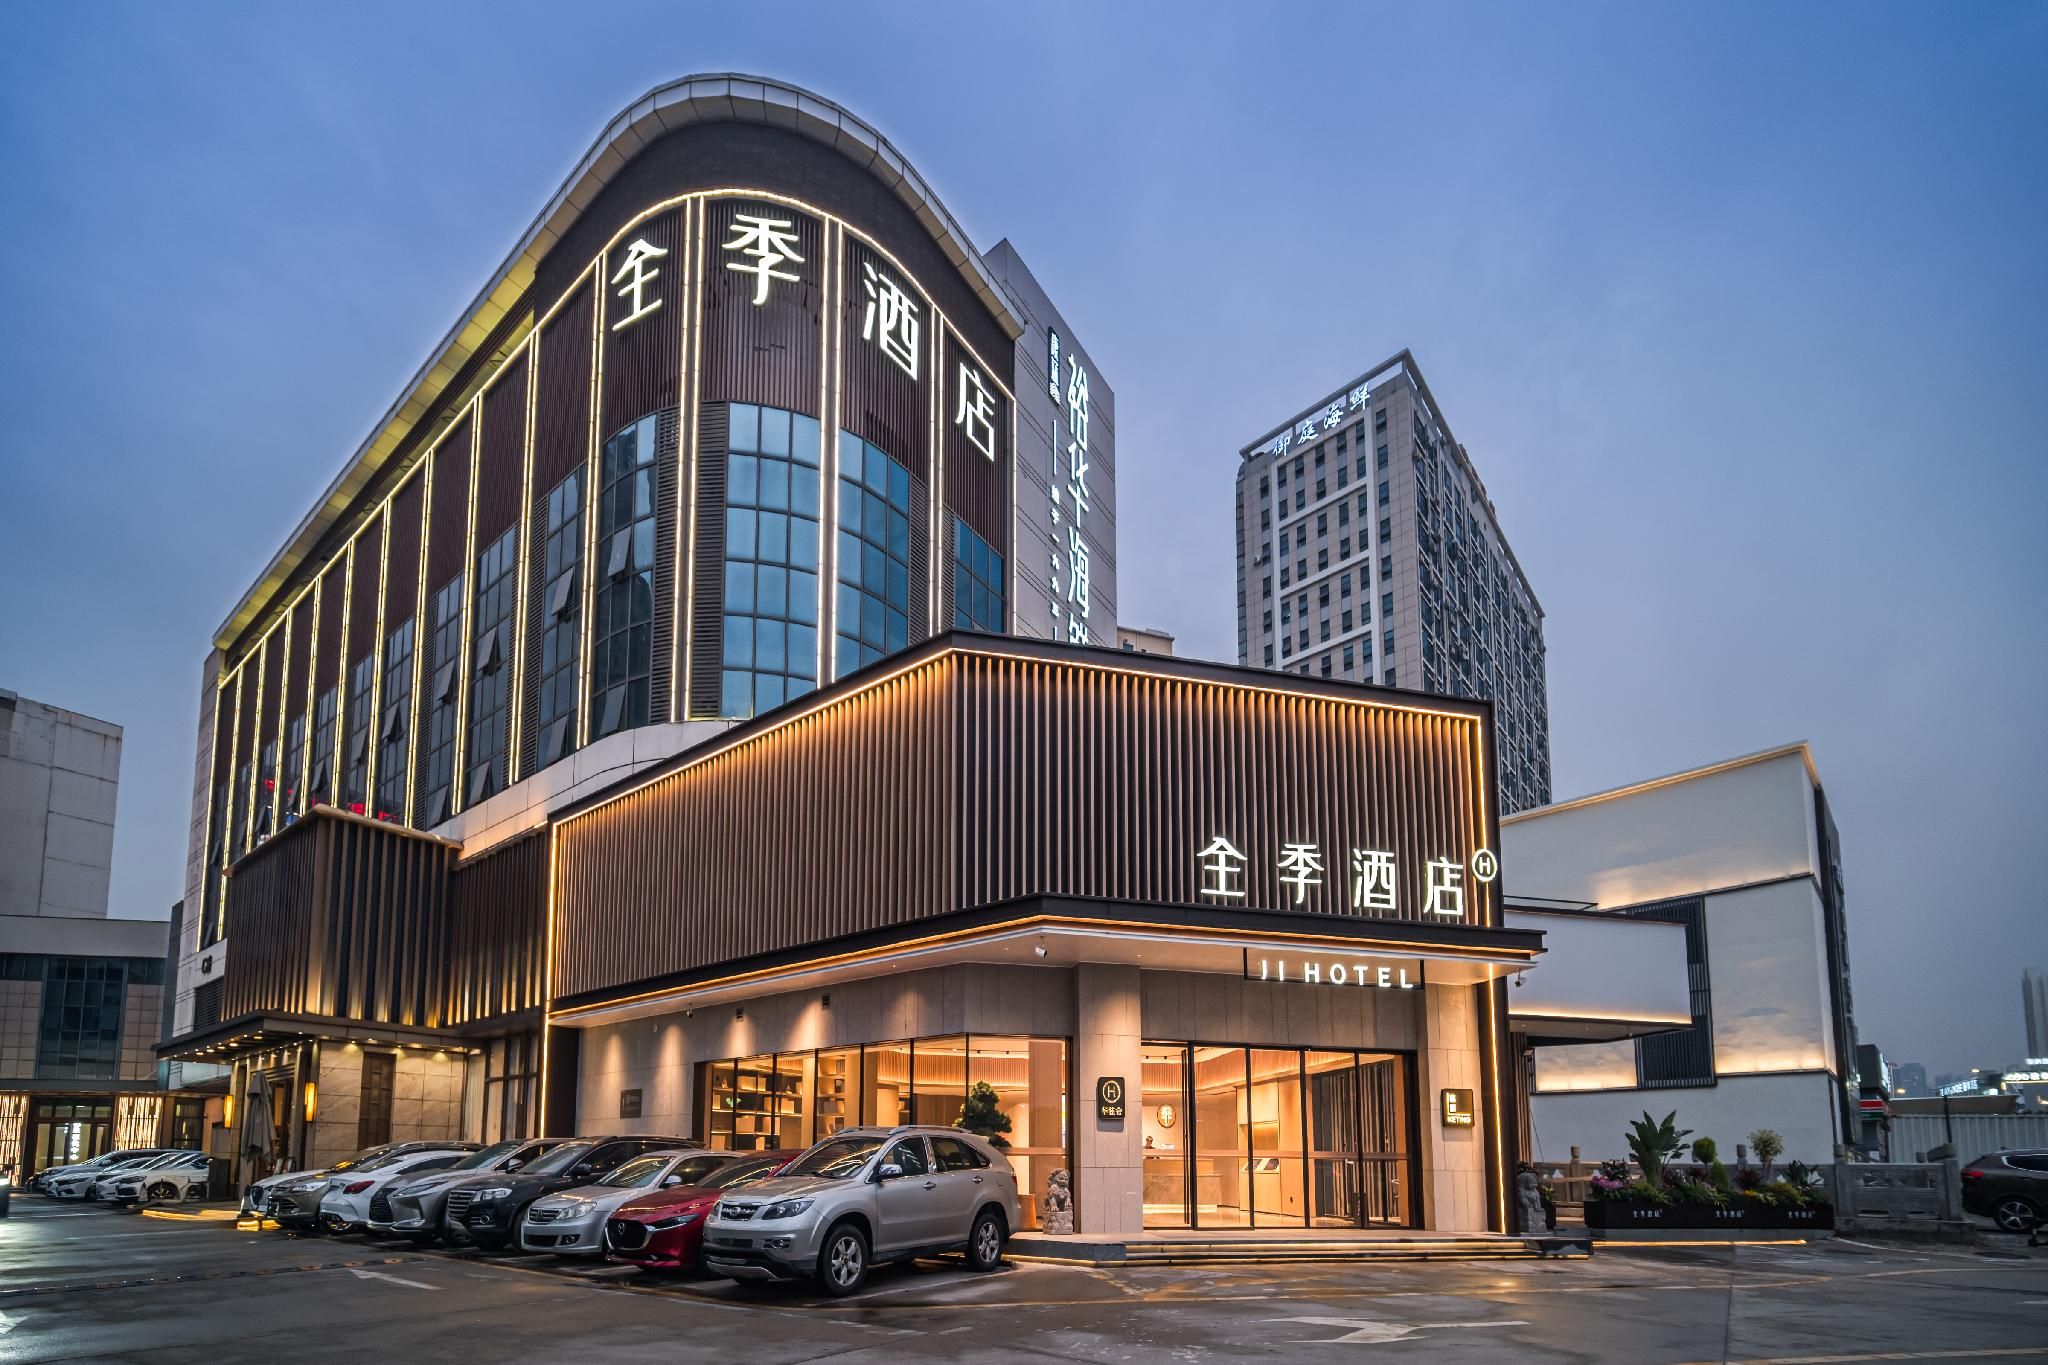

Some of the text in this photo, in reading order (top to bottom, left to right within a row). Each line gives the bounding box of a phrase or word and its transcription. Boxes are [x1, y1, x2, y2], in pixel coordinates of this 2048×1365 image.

[612, 213, 995, 462] 全季酒店
[1272, 382, 1371, 457] 御庭海鲜
[1197, 836, 1465, 916] 全季酒店
[1260, 959, 1414, 989] JI HOTEL
